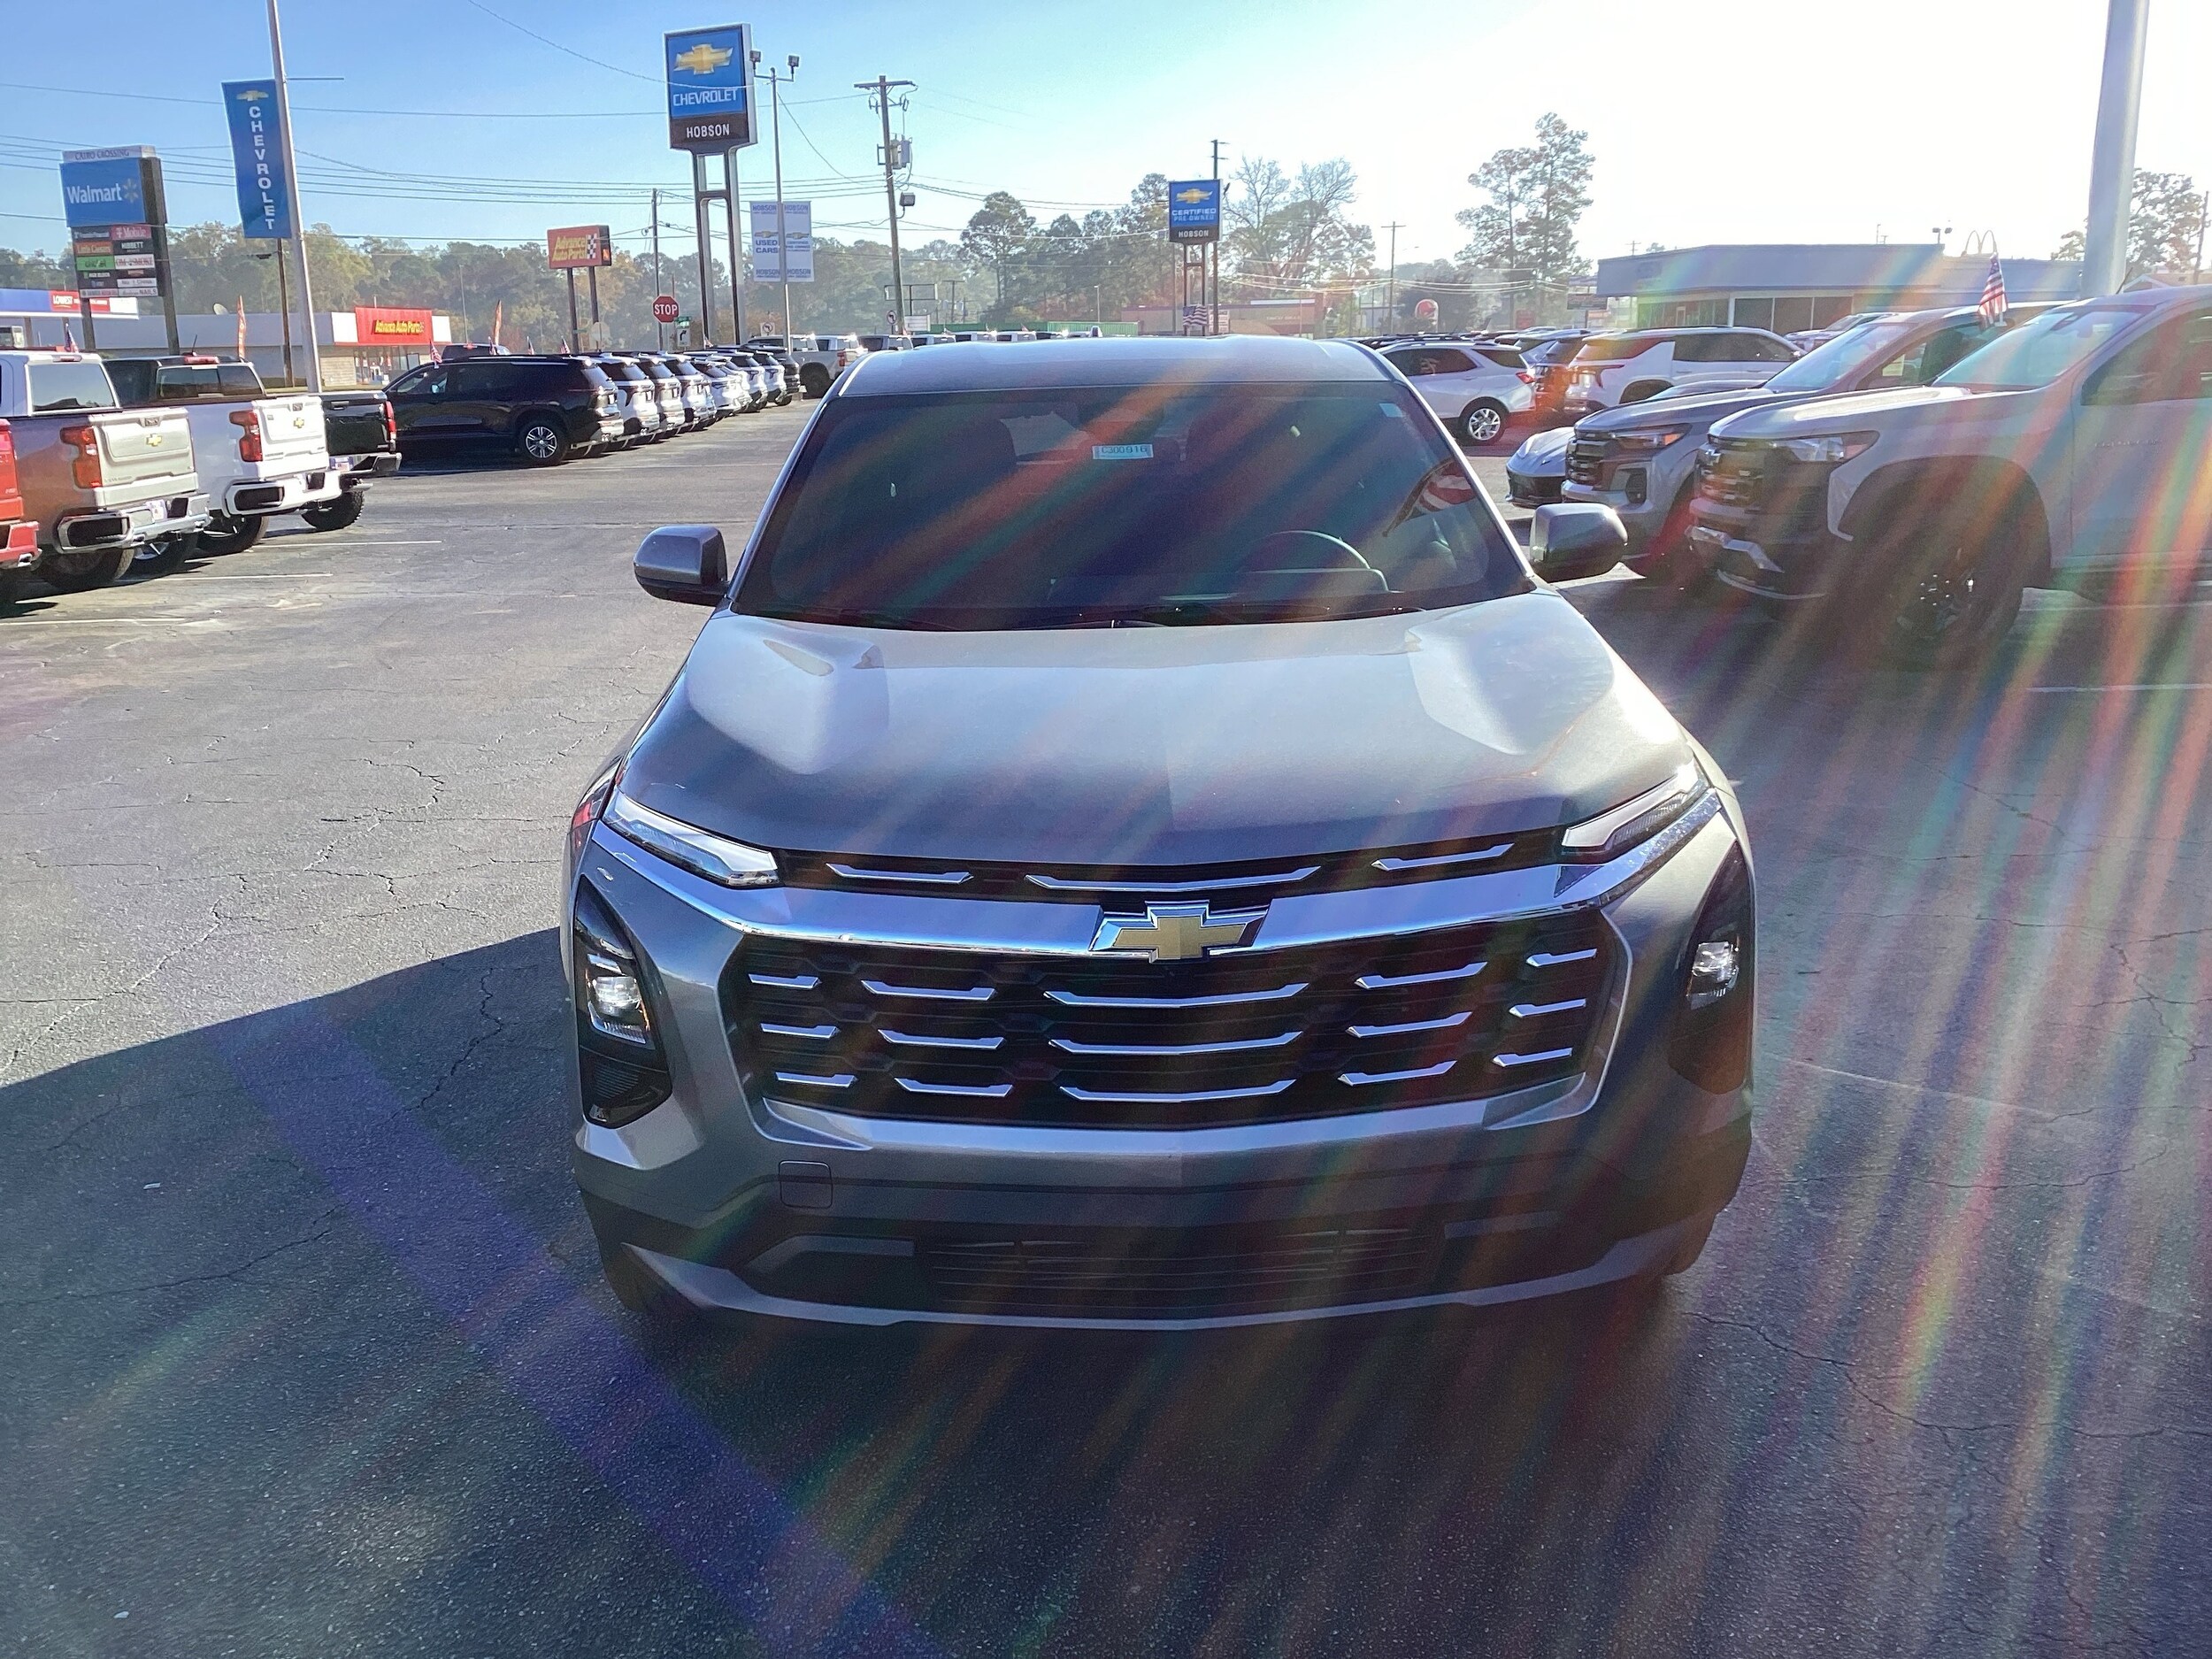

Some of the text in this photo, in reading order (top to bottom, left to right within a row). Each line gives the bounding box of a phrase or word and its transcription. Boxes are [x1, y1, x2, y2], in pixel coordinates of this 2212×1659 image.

[672, 88, 738, 106] CHEVROLET
[686, 123, 730, 138] HOBSON
[96, 148, 130, 158] CROSSING
[249, 106, 276, 230] CHEVROLET
[66, 182, 123, 204] Walmart
[1171, 207, 1217, 216] CERTIFIED
[1178, 229, 1210, 238] HOBSON
[555, 236, 586, 250] Advance
[551, 248, 587, 262] Auto Parts
[654, 303, 678, 315] STOP
